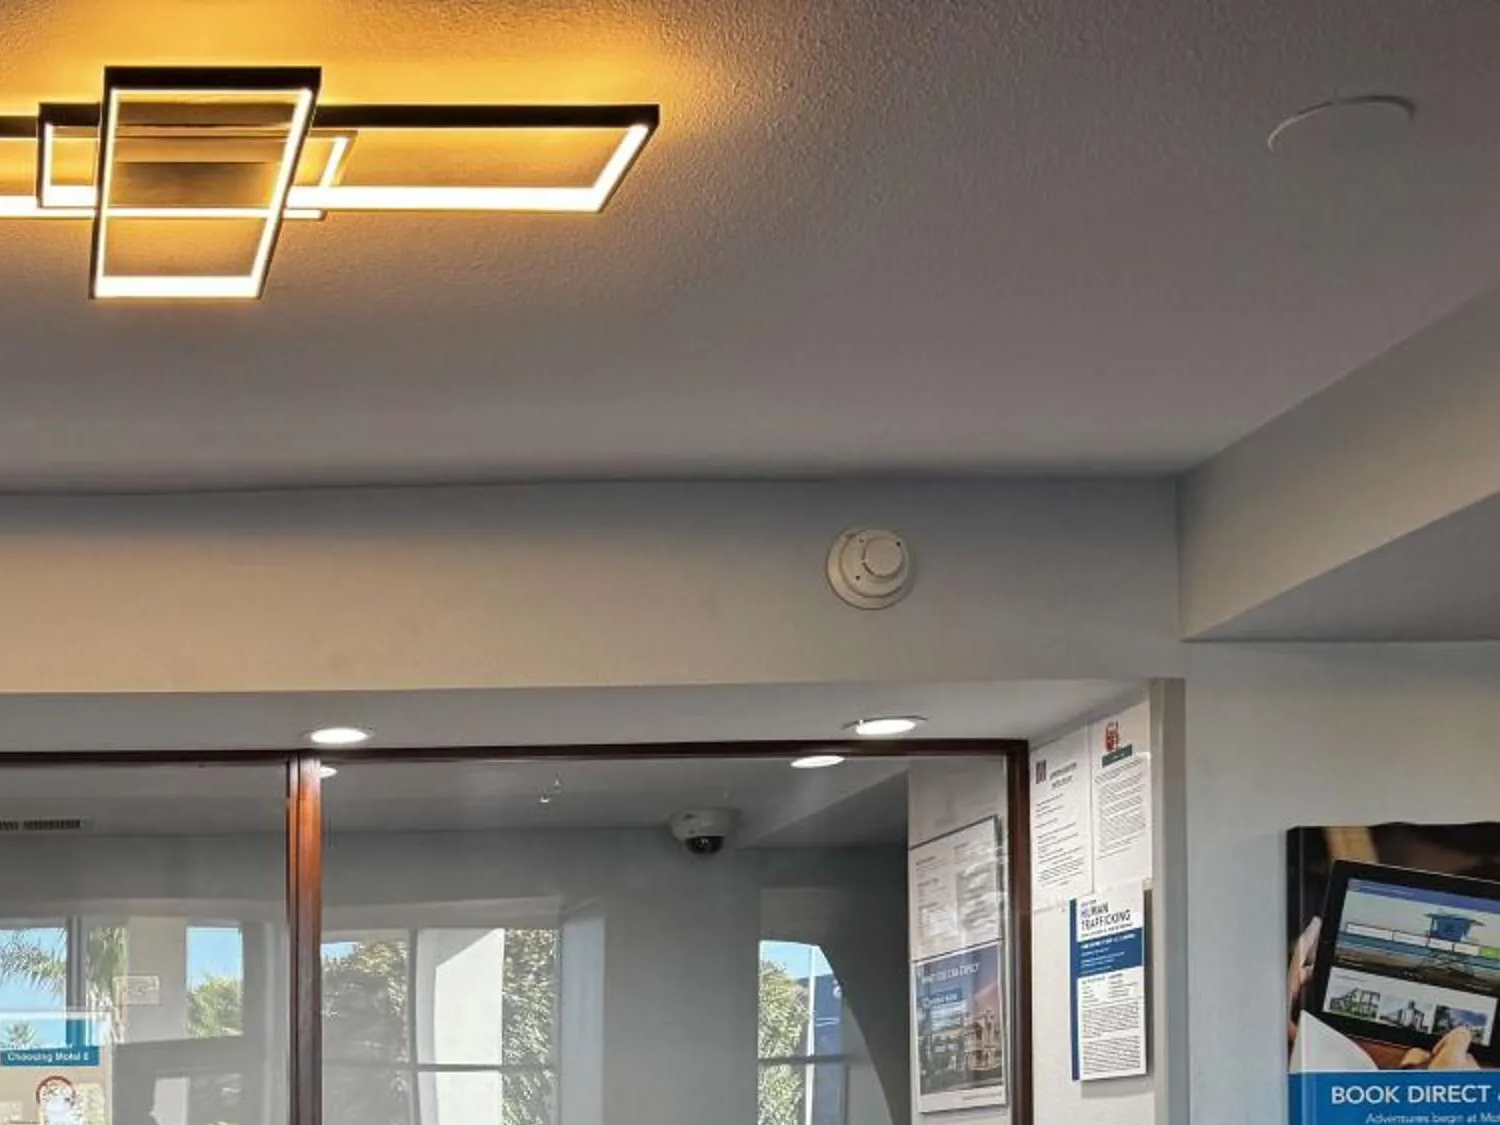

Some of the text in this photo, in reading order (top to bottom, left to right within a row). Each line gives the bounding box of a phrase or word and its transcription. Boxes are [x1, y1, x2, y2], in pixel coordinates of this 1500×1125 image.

[1081, 903, 1109, 919] HUMAN
[1081, 909, 1131, 931] TRAFFICKING
[7, 1051, 53, 1063] Choosing
[55, 1051, 81, 1061] Motel
[1330, 1085, 1401, 1105] BOOK
[1407, 1084, 1493, 1103] DIRECT
[1365, 1112, 1430, 1125] Adventures
[1466, 1112, 1477, 1124] at
